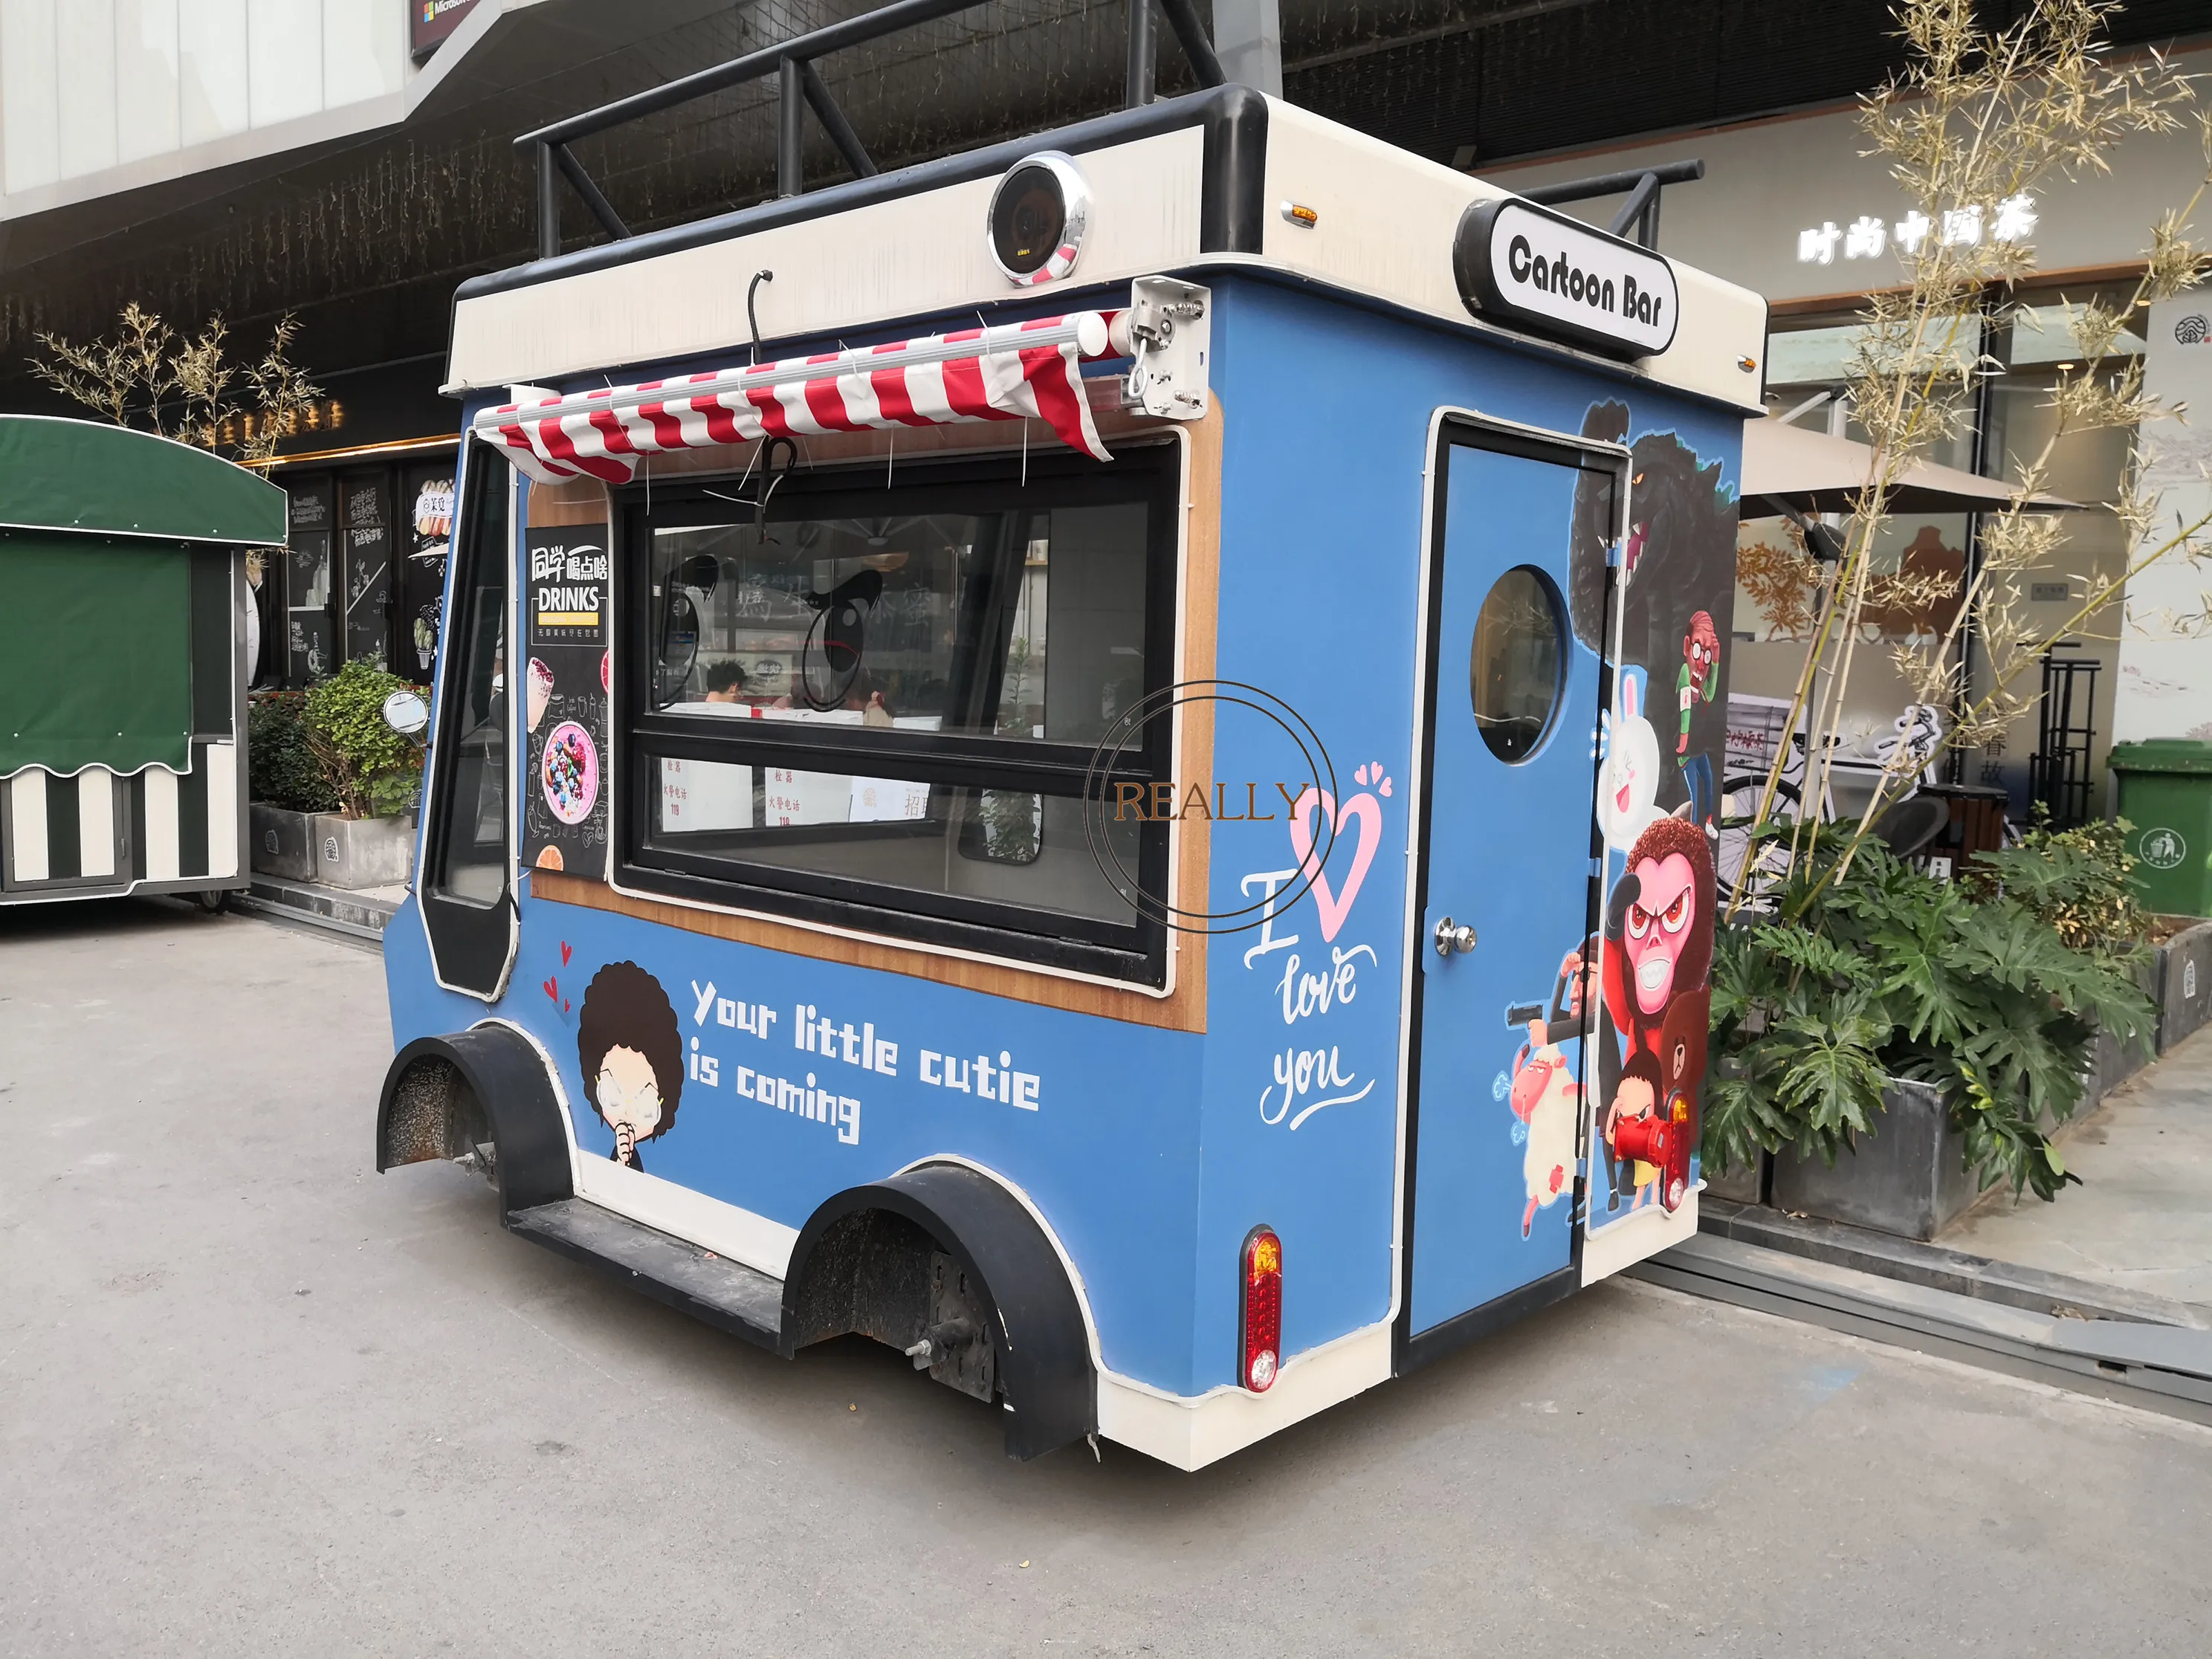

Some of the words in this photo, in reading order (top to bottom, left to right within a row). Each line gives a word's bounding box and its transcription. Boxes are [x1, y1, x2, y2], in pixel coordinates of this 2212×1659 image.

[435, 0, 466, 15] Microso
[1797, 194, 2039, 265] 时尚中国茶
[1508, 234, 1614, 313] Cartoon
[1623, 274, 1662, 327] Bar
[531, 545, 608, 583] 同学喝点啥
[538, 586, 599, 611] DRINKS
[664, 784, 687, 800] 火警电话
[670, 803, 679, 816] 119
[769, 796, 800, 812] 火警电话
[1275, 944, 1377, 1024] love
[795, 1004, 899, 1076] little
[920, 1050, 1041, 1112] cutie
[1260, 1045, 1359, 1125] you
[690, 1036, 719, 1087] is
[737, 1066, 861, 1145] coming
